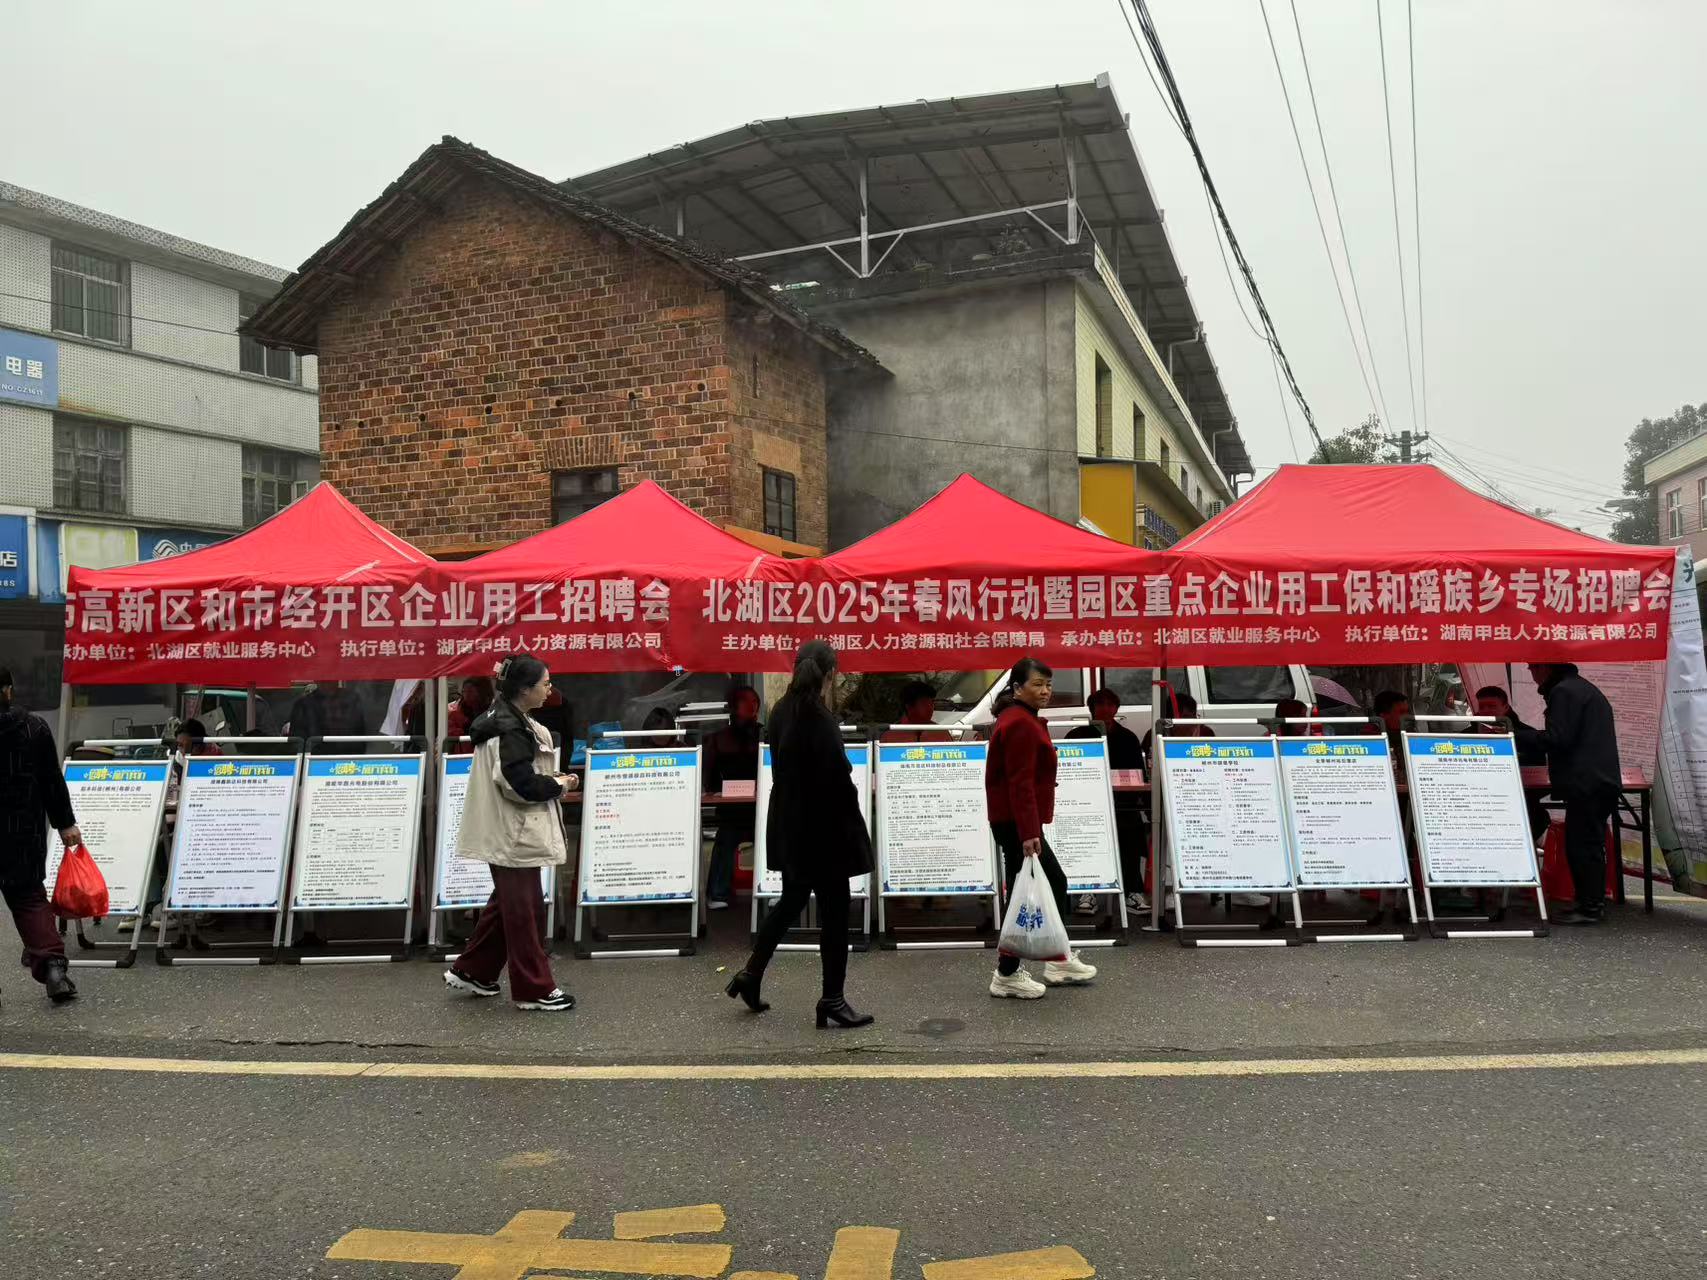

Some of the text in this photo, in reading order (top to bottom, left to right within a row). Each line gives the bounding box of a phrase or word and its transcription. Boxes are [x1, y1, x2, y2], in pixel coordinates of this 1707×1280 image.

[5, 355, 43, 379] 电器
[702, 568, 1671, 625] 北湖区2025年春风行动暨园区重点企业用工保和瑶族乡专场招聘会
